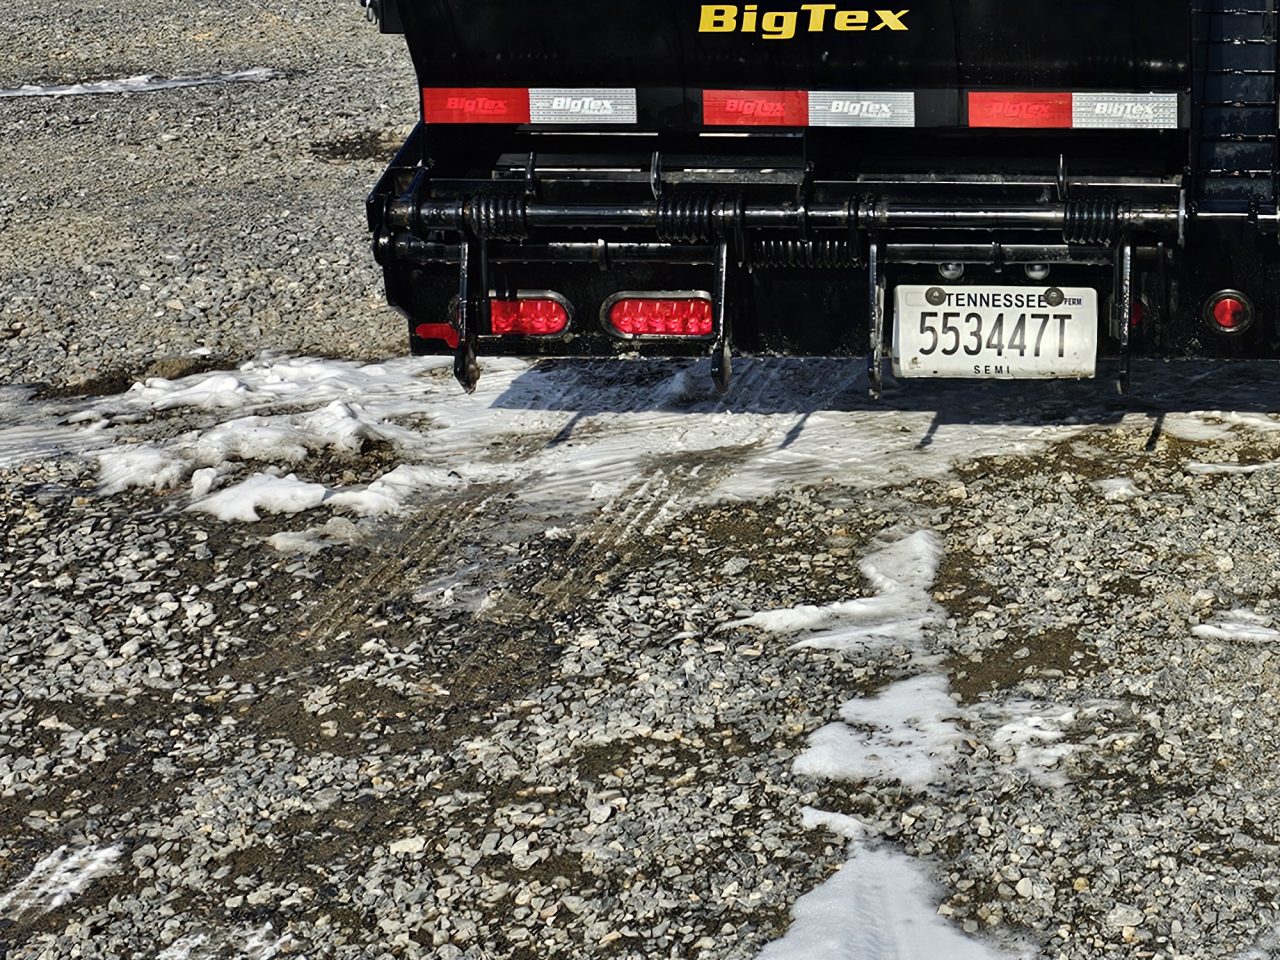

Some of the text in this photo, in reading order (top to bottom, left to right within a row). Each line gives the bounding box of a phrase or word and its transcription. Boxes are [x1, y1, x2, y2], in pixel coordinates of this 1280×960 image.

[698, 4, 910, 39] BigTex
[446, 97, 508, 113] BigTex
[552, 97, 614, 112] BigTex
[831, 100, 892, 116] BigTex
[1095, 102, 1157, 118] BigTex
[945, 293, 1048, 308] TENNESSEE
[918, 311, 1072, 357] 553447T
[973, 365, 1010, 374] SEMI
